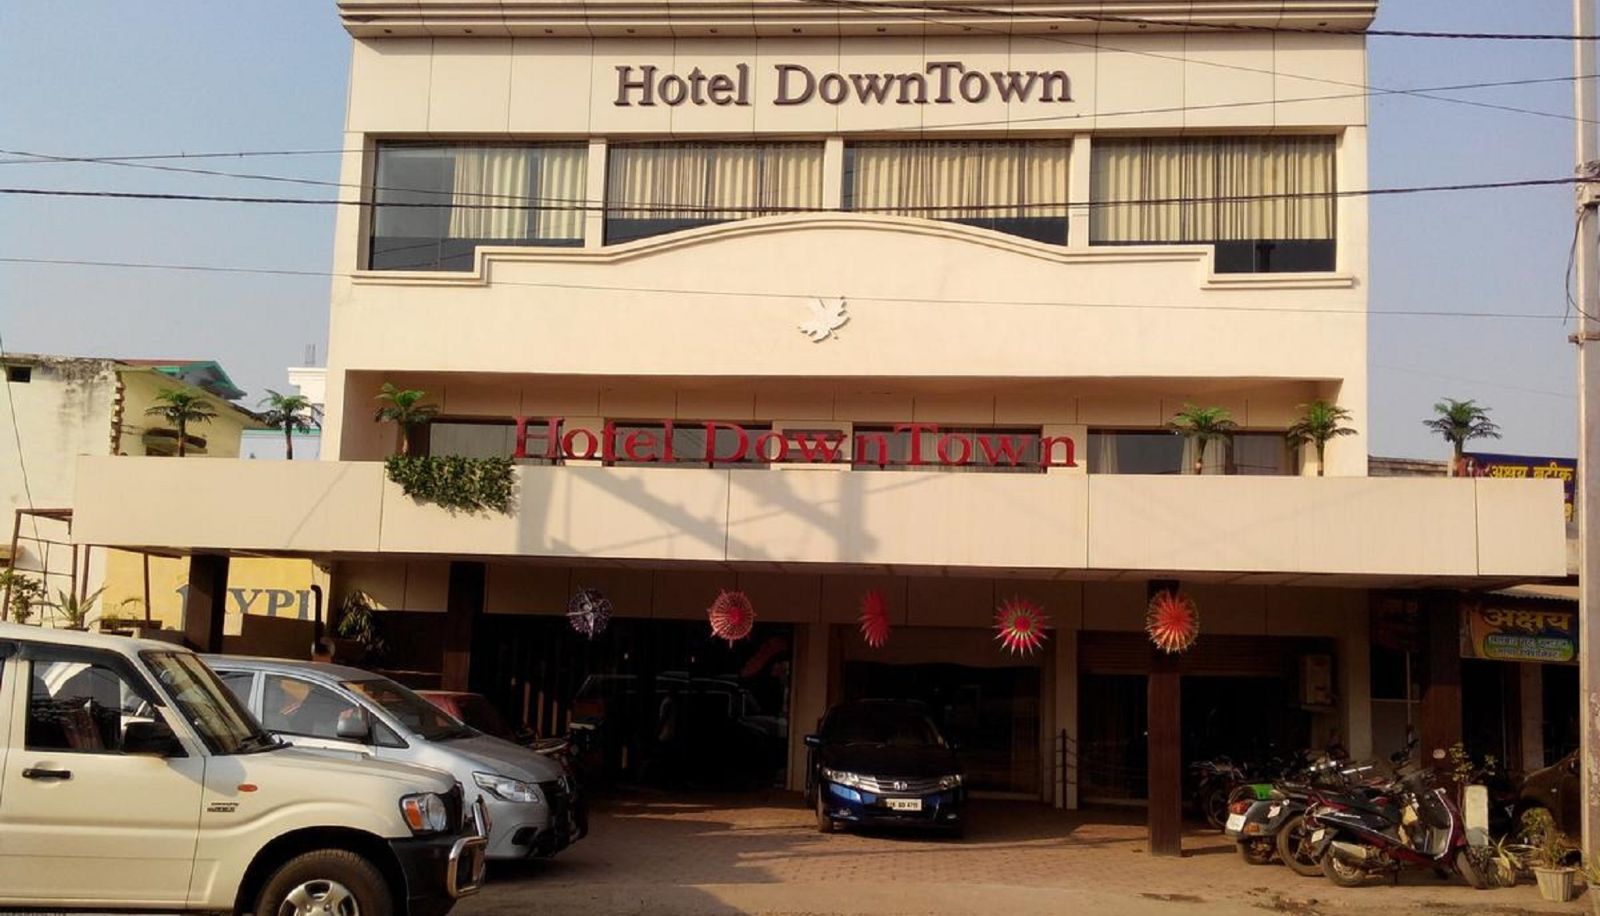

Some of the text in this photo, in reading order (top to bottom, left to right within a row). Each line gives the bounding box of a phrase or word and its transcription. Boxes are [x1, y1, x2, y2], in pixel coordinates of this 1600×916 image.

[613, 61, 1073, 106] Hotel DownTown
[512, 416, 1078, 467] Hotel DownTown
[1483, 608, 1573, 632] अक्षय
